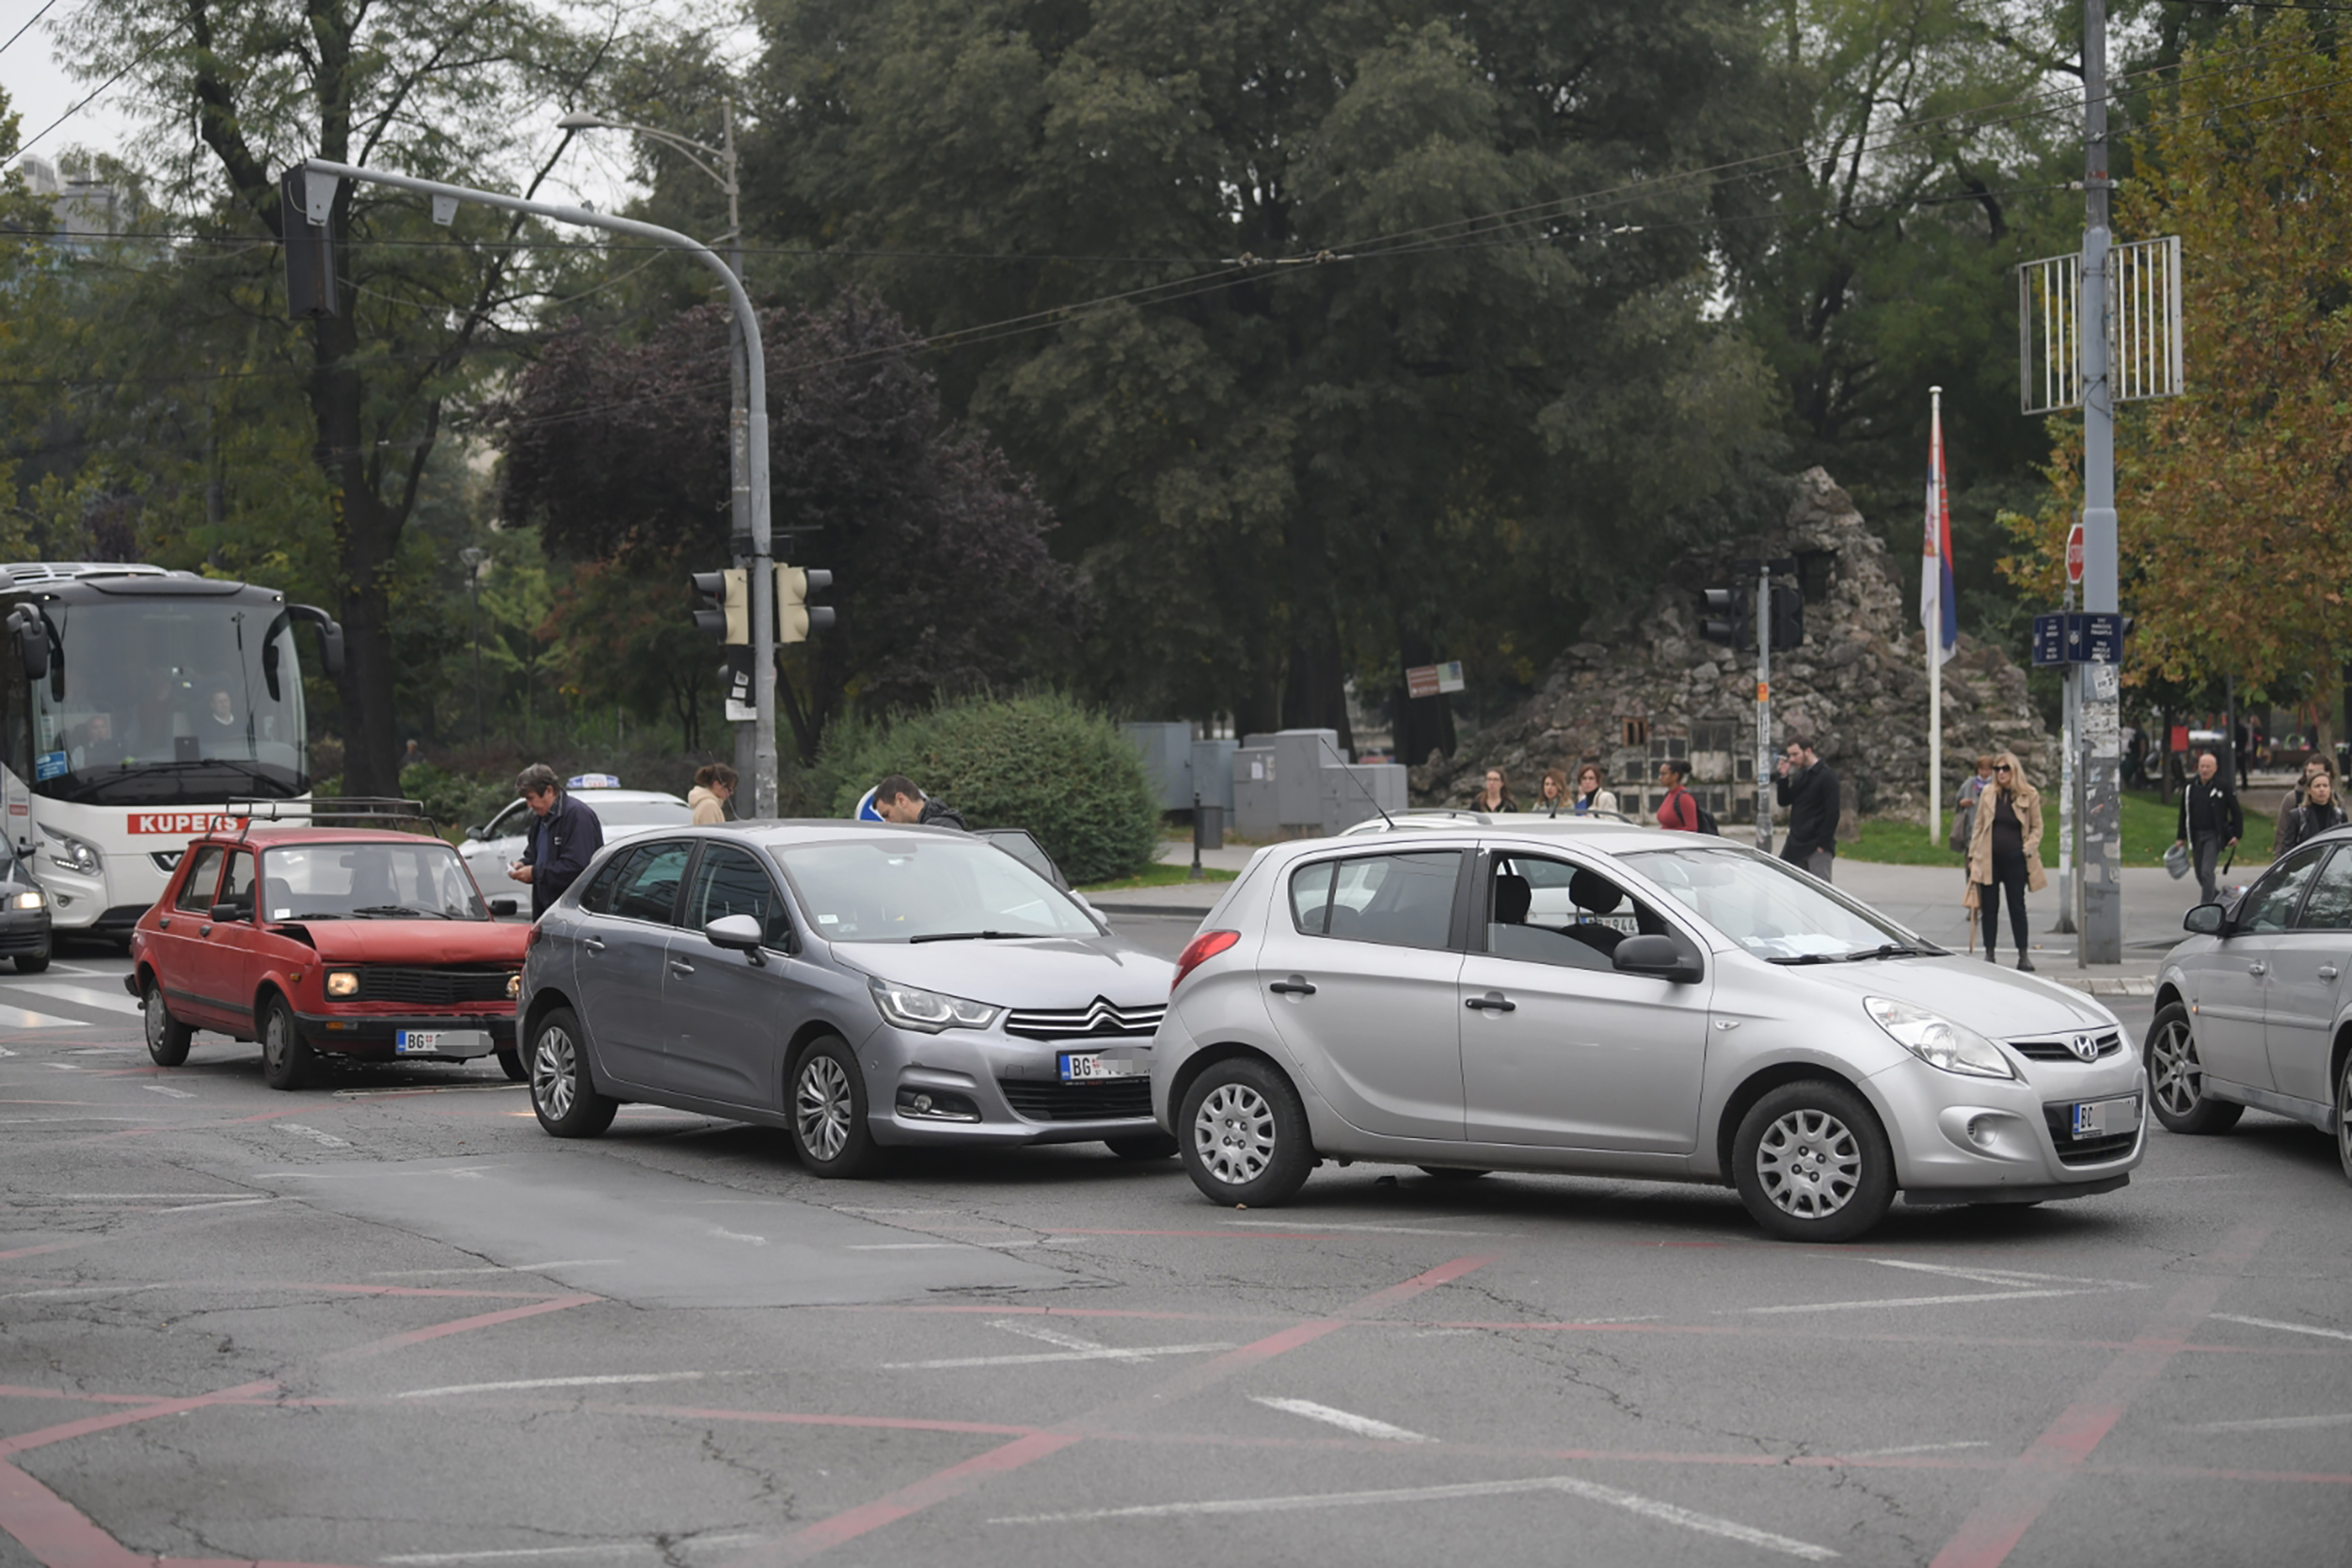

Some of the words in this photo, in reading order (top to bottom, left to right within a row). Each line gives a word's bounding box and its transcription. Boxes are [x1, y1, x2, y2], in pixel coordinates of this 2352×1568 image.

[139, 815, 238, 832] KUPERS
[408, 1034, 424, 1049] BG
[1073, 1057, 1091, 1077] BG
